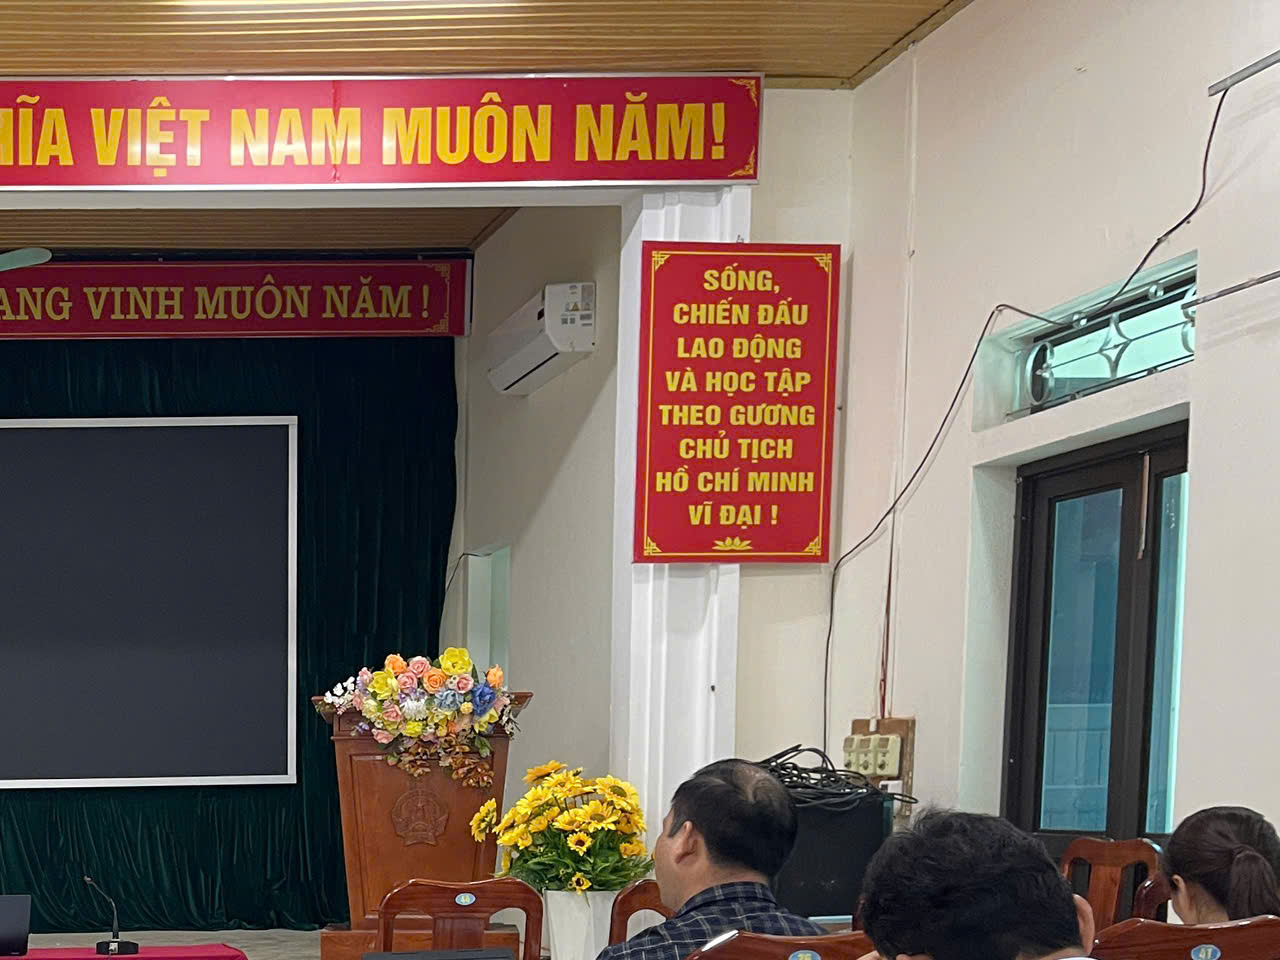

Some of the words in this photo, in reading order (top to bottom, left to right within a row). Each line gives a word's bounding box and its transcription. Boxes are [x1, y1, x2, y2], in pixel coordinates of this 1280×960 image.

[91, 96, 206, 177] VIỆT
[230, 107, 362, 167] NAM
[382, 92, 552, 166] MUÔN
[575, 92, 725, 161] NĂM!
[704, 264, 780, 293] SỐNG,
[83, 288, 184, 320] VINH
[195, 276, 311, 320] MUÔN
[323, 277, 408, 318] NĂM
[423, 285, 429, 316] !
[673, 297, 749, 324] CHIẾN
[757, 297, 808, 325] ĐẤU
[677, 337, 724, 358] LAO
[733, 334, 801, 363] ĐỘNG
[666, 368, 697, 392] VÀ
[706, 371, 756, 396] HỌC
[764, 368, 811, 396] TẬP
[659, 405, 721, 425] THEO
[730, 403, 815, 426] GƯƠNG
[680, 430, 729, 459] CHỦ
[738, 439, 792, 463] TỊCH
[656, 465, 688, 492] HỒ
[698, 468, 739, 492] CHÍ
[748, 472, 814, 492] MINH
[689, 501, 712, 525] VĨ
[720, 505, 761, 528] ĐẠI
[771, 505, 778, 524] !
